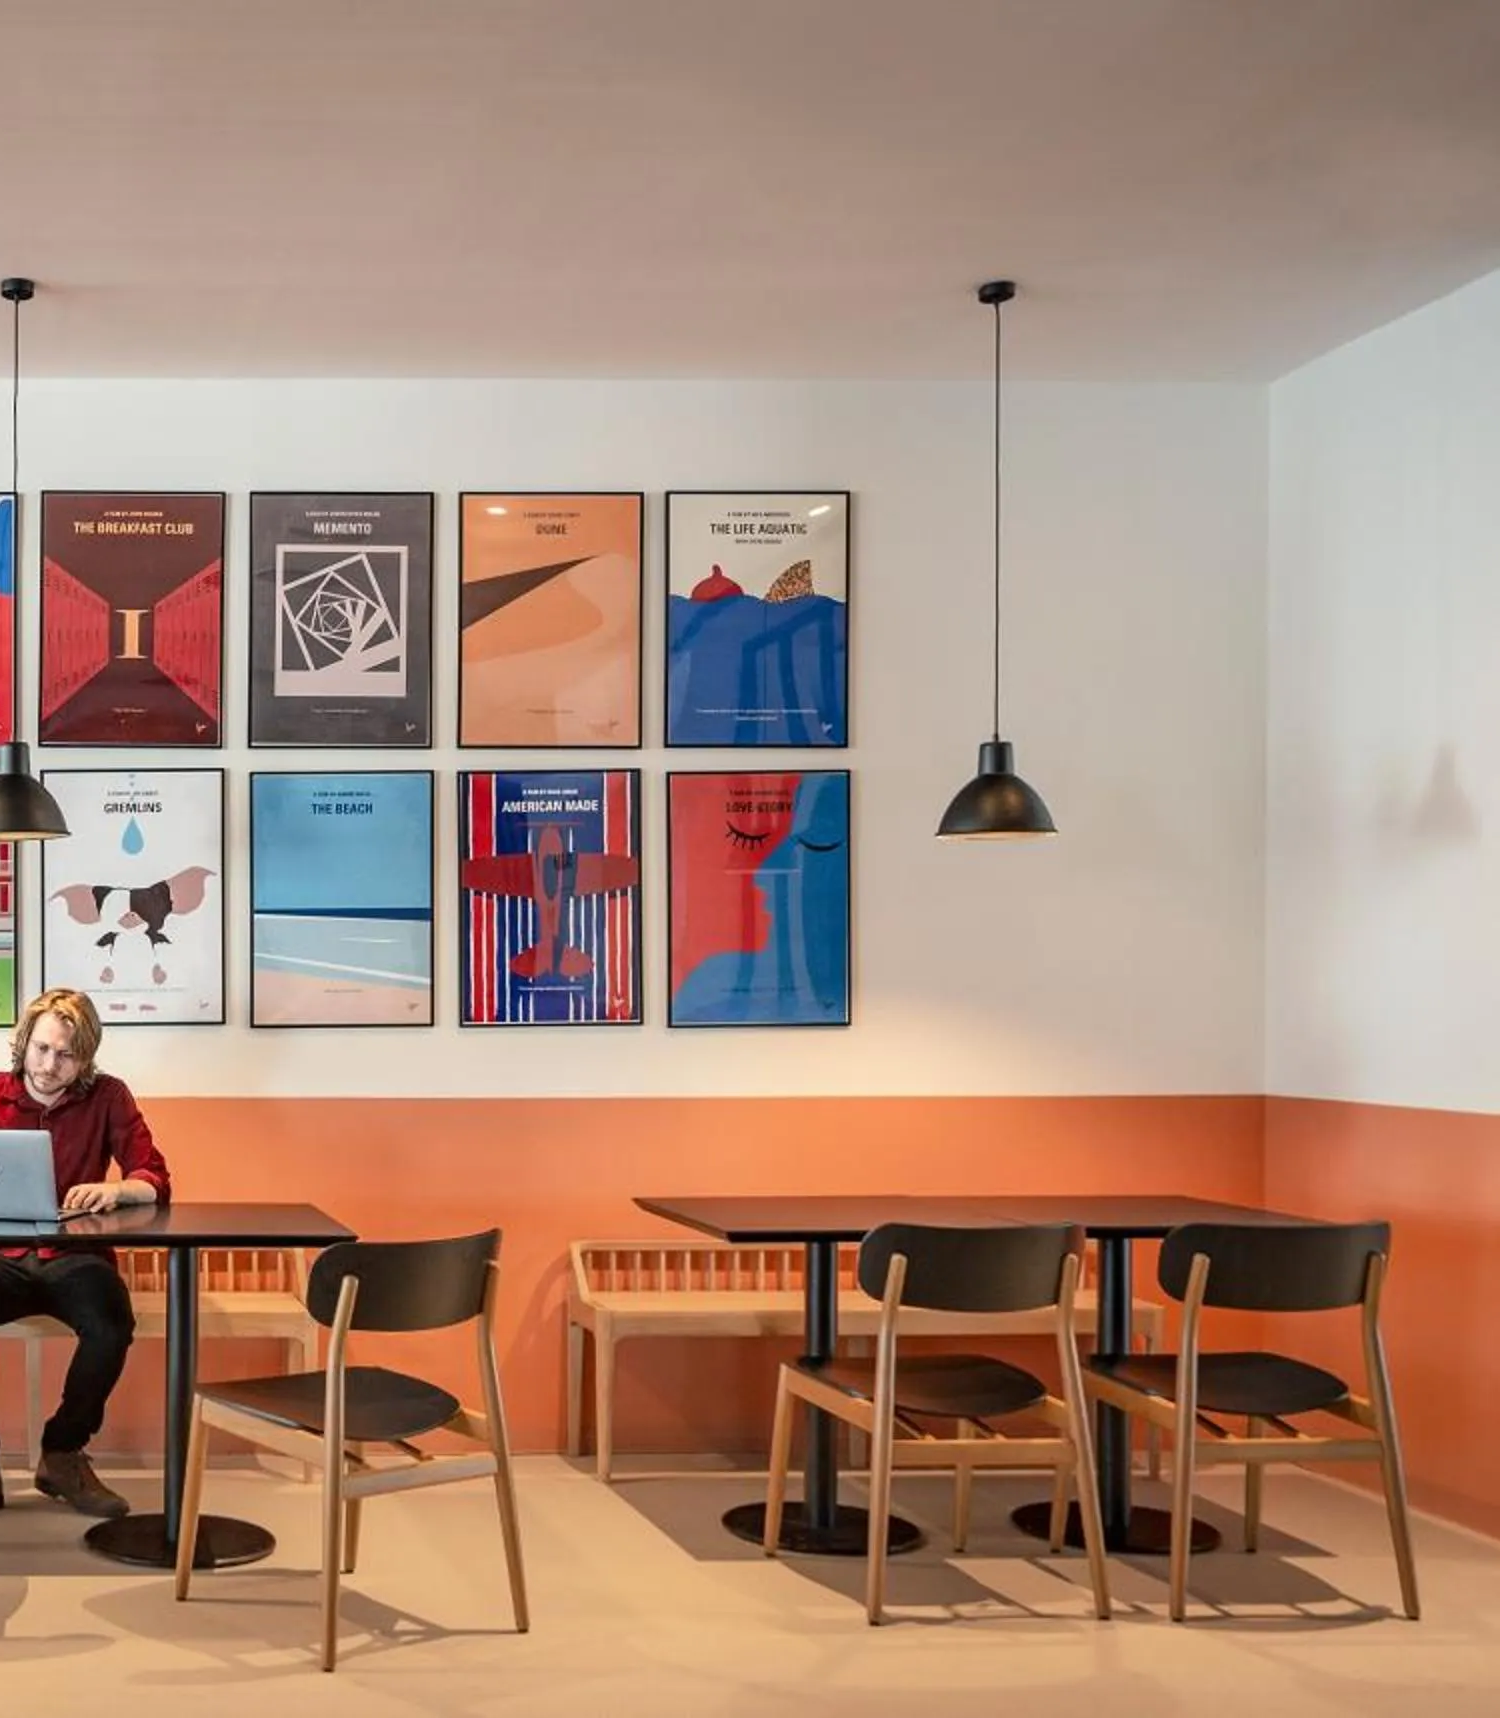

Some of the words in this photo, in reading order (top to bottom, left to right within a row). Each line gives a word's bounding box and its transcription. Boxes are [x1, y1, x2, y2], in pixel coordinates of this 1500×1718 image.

[74, 522, 95, 534] THE
[97, 522, 163, 535] BREAKFAST
[165, 522, 194, 535] CLUB
[313, 522, 372, 535] MEMENTO
[536, 523, 568, 535] DUNE
[710, 523, 731, 535] THE
[733, 523, 755, 535] LIFE
[758, 523, 807, 535] AQUATIC
[103, 802, 162, 813] GREMLINS
[311, 803, 332, 815] THE
[335, 803, 373, 815] BEACH
[502, 800, 562, 812] AMERICAN
[566, 799, 599, 811] MADE
[726, 802, 753, 813] LOVE
